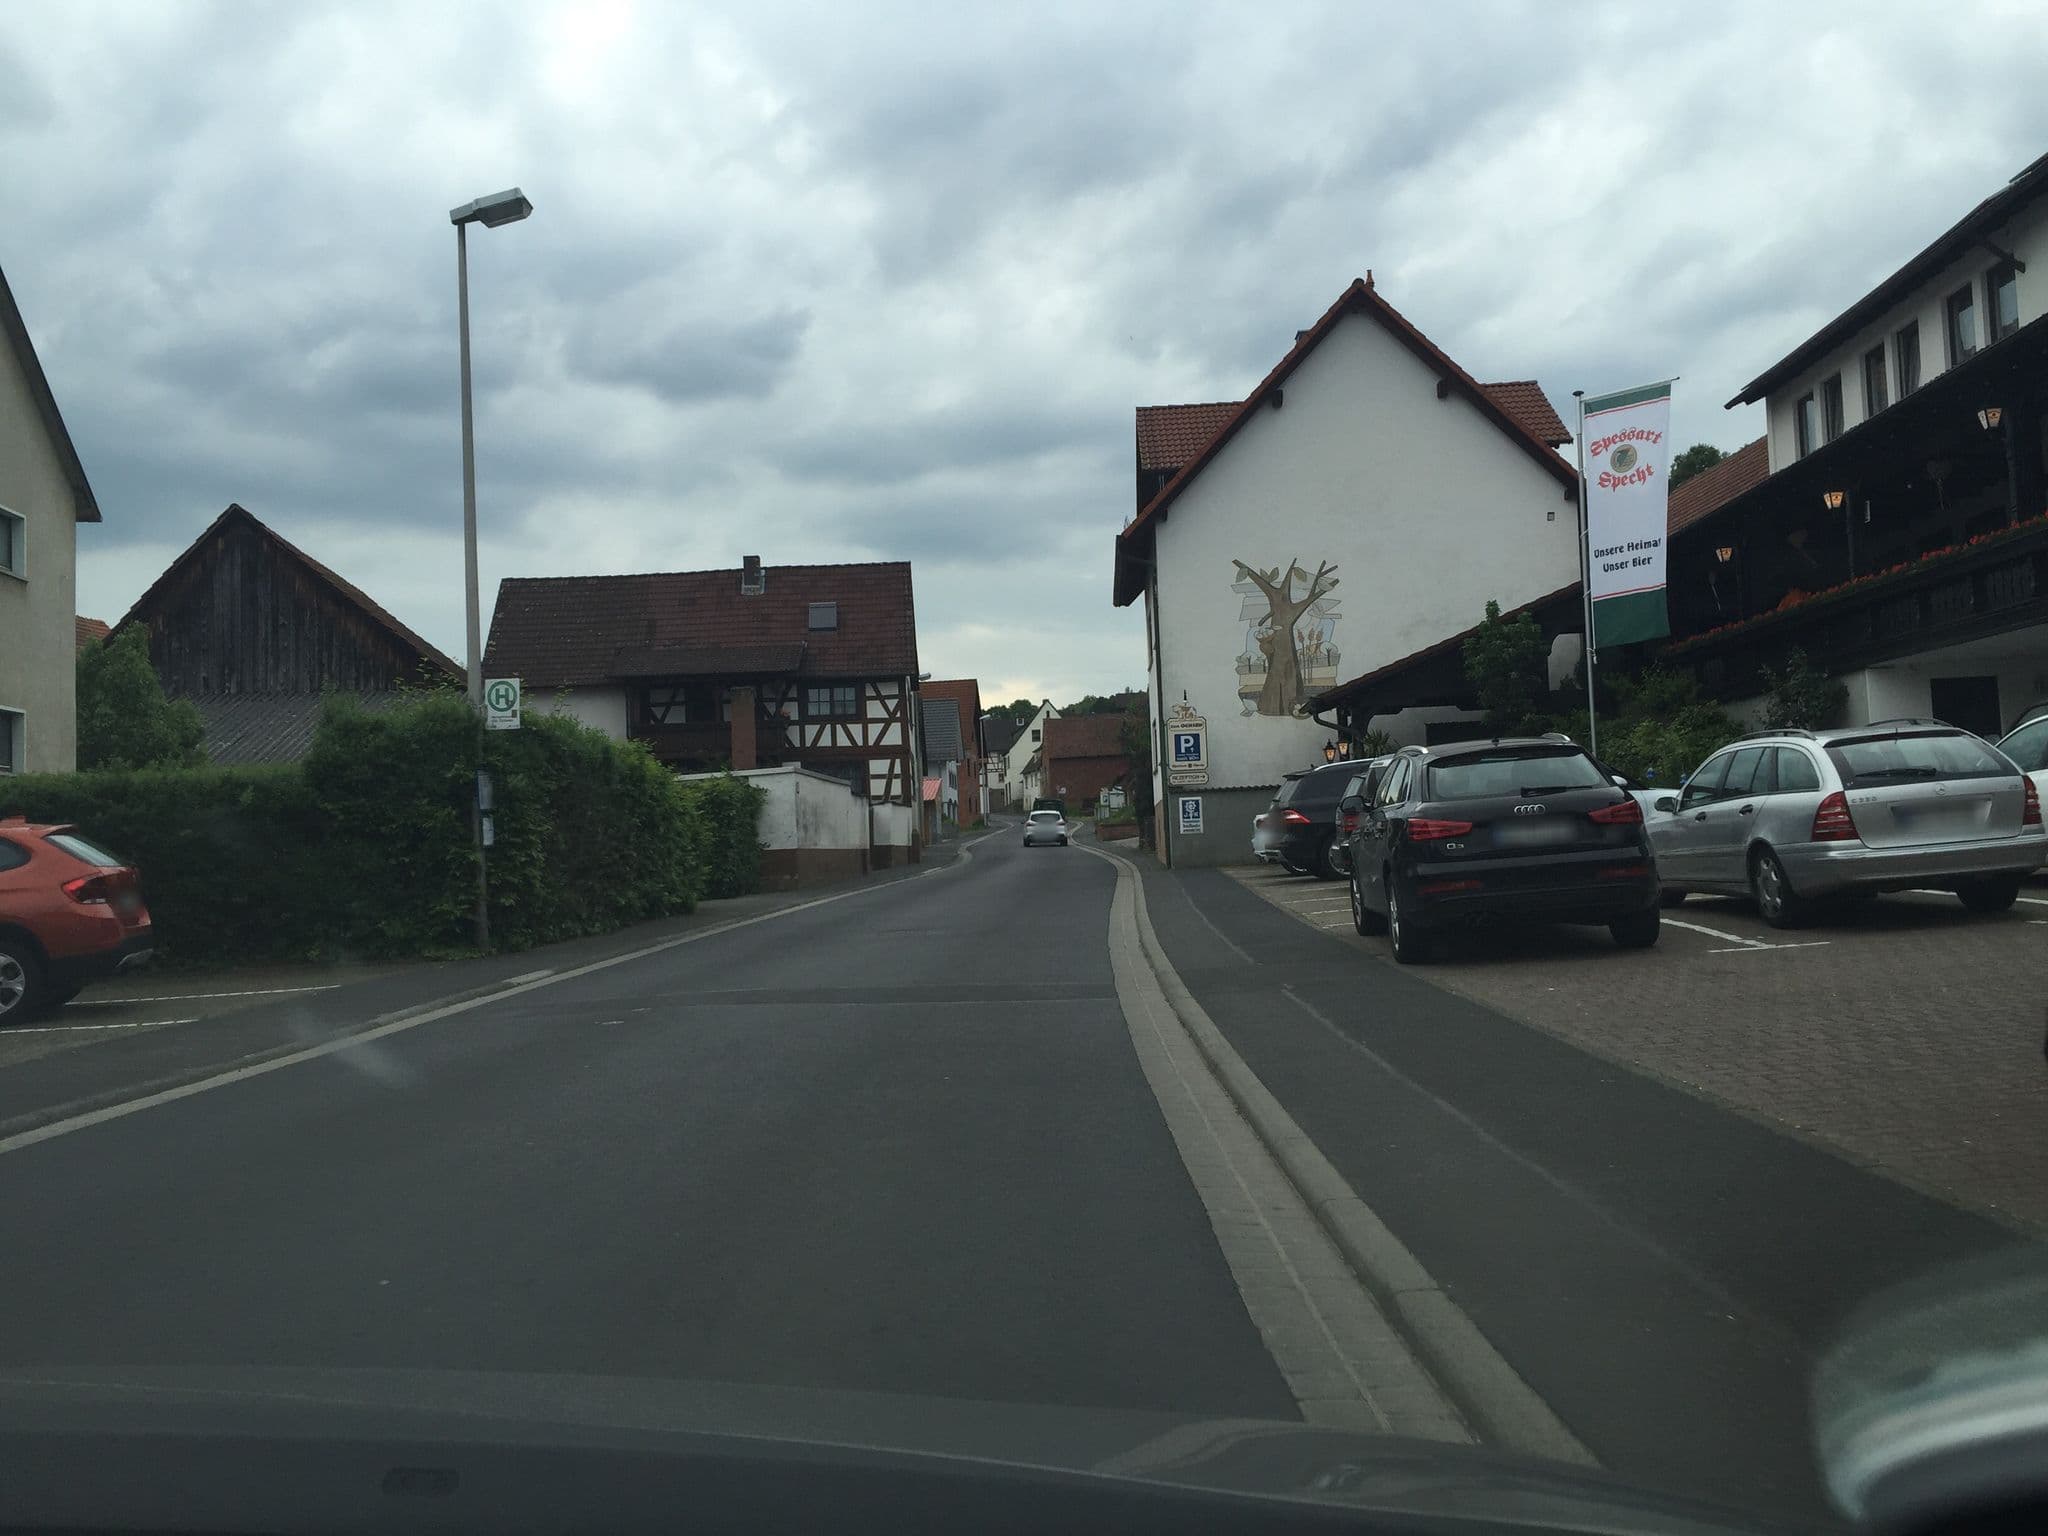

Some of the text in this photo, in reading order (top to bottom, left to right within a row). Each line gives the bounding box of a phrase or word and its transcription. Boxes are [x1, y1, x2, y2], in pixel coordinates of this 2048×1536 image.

[1590, 426, 1662, 458] Spessart
[1597, 463, 1654, 493] Specht
[1593, 545, 1625, 559] Unsere
[1602, 556, 1653, 573] Unser Bier
[495, 687, 510, 706] H
[1180, 735, 1194, 754] P
